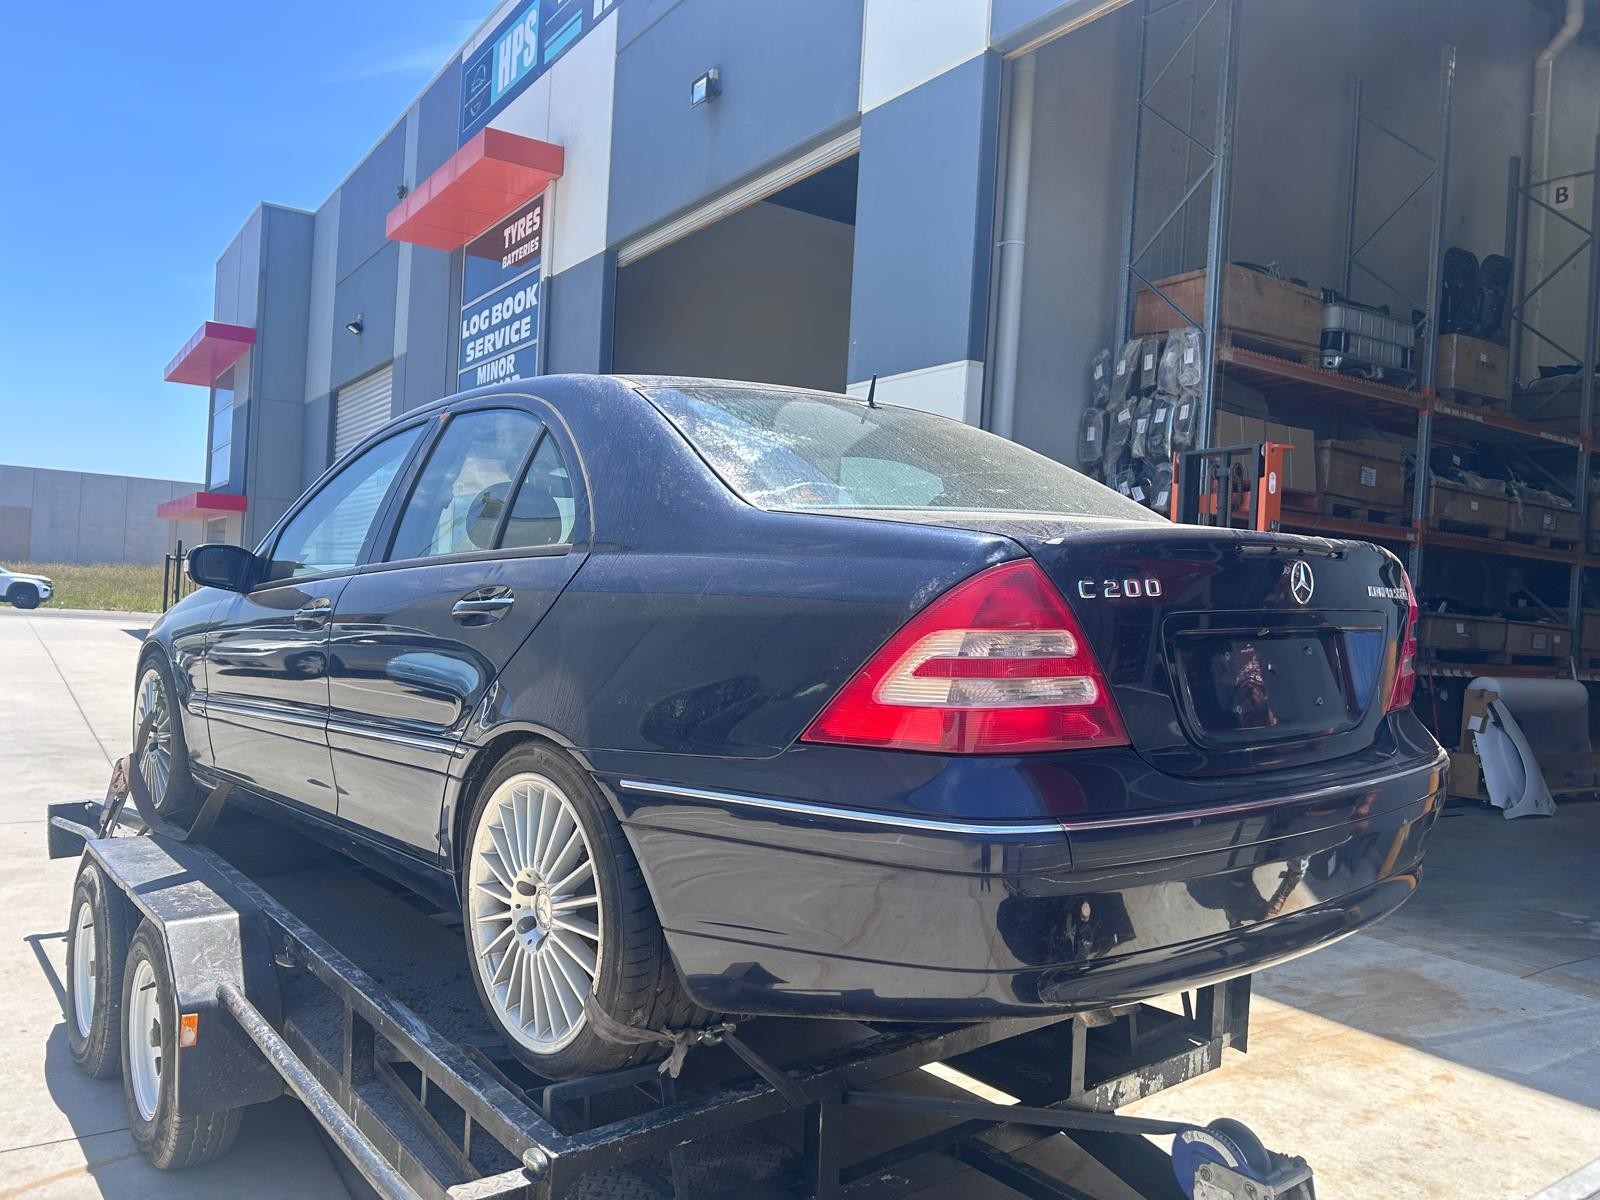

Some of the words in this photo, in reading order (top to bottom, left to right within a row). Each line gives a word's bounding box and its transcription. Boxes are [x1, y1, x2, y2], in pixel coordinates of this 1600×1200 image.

[498, 9, 537, 93] HPS
[1556, 186, 1569, 204] B
[504, 206, 541, 249] TYRES
[502, 236, 540, 269] BATTERIES
[462, 309, 490, 339] LOG
[491, 282, 539, 326] BOOK
[466, 316, 532, 363] SERVICE
[476, 353, 516, 386] MINOR
[1078, 580, 1097, 599] C
[1103, 579, 1162, 598] 200
